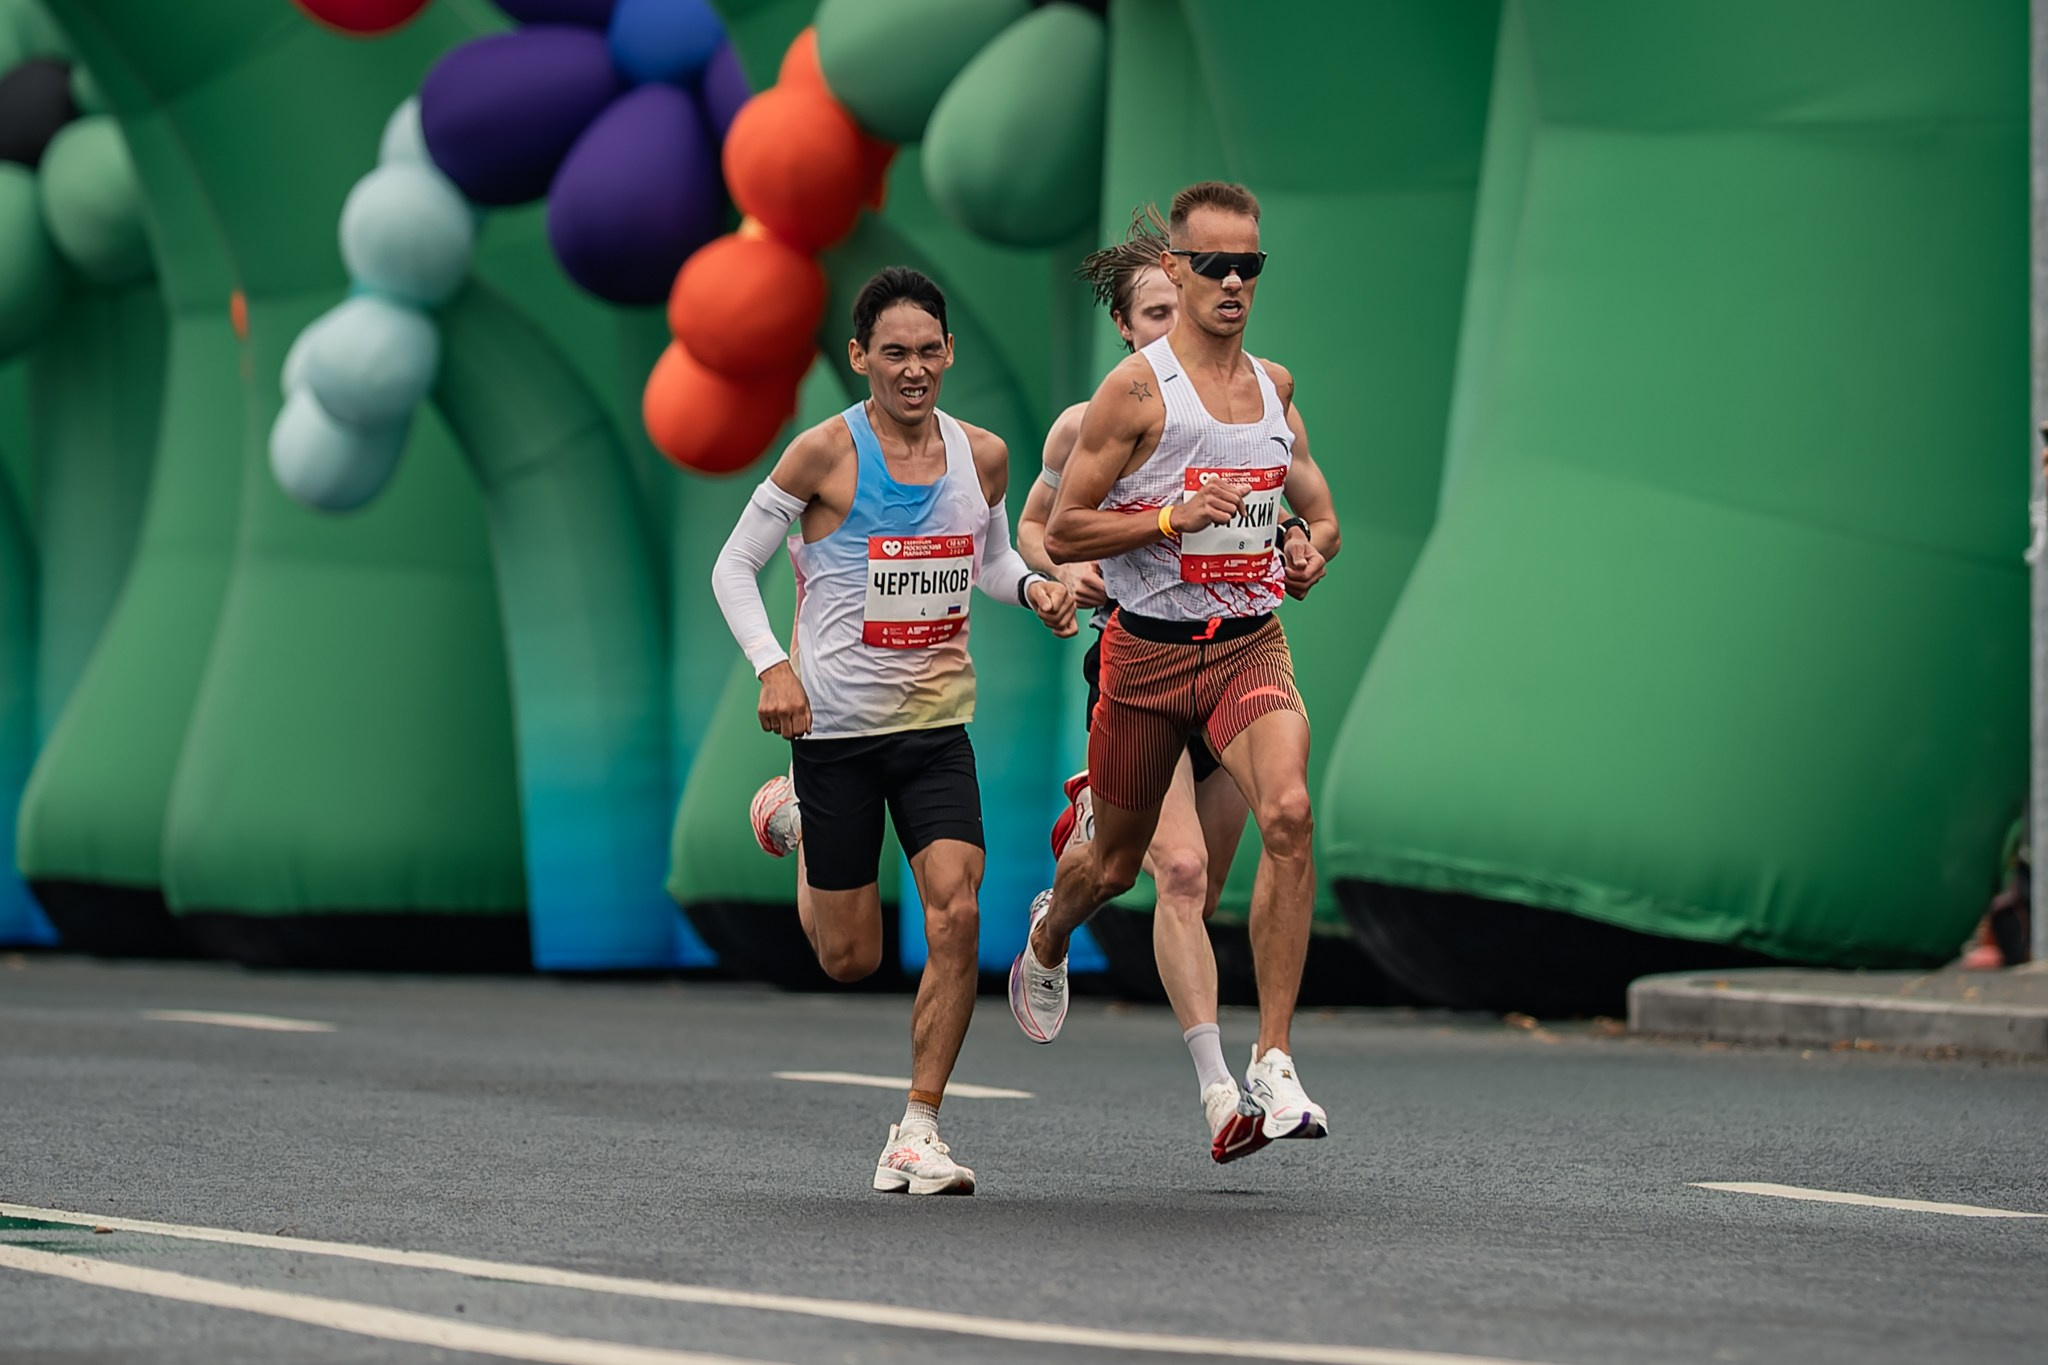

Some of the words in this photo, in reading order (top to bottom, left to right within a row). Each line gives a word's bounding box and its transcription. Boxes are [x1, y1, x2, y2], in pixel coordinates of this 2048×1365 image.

[1238, 541, 1245, 550] 8
[874, 568, 969, 595] ЧЕРТЫКОВ
[920, 607, 926, 616] 4
